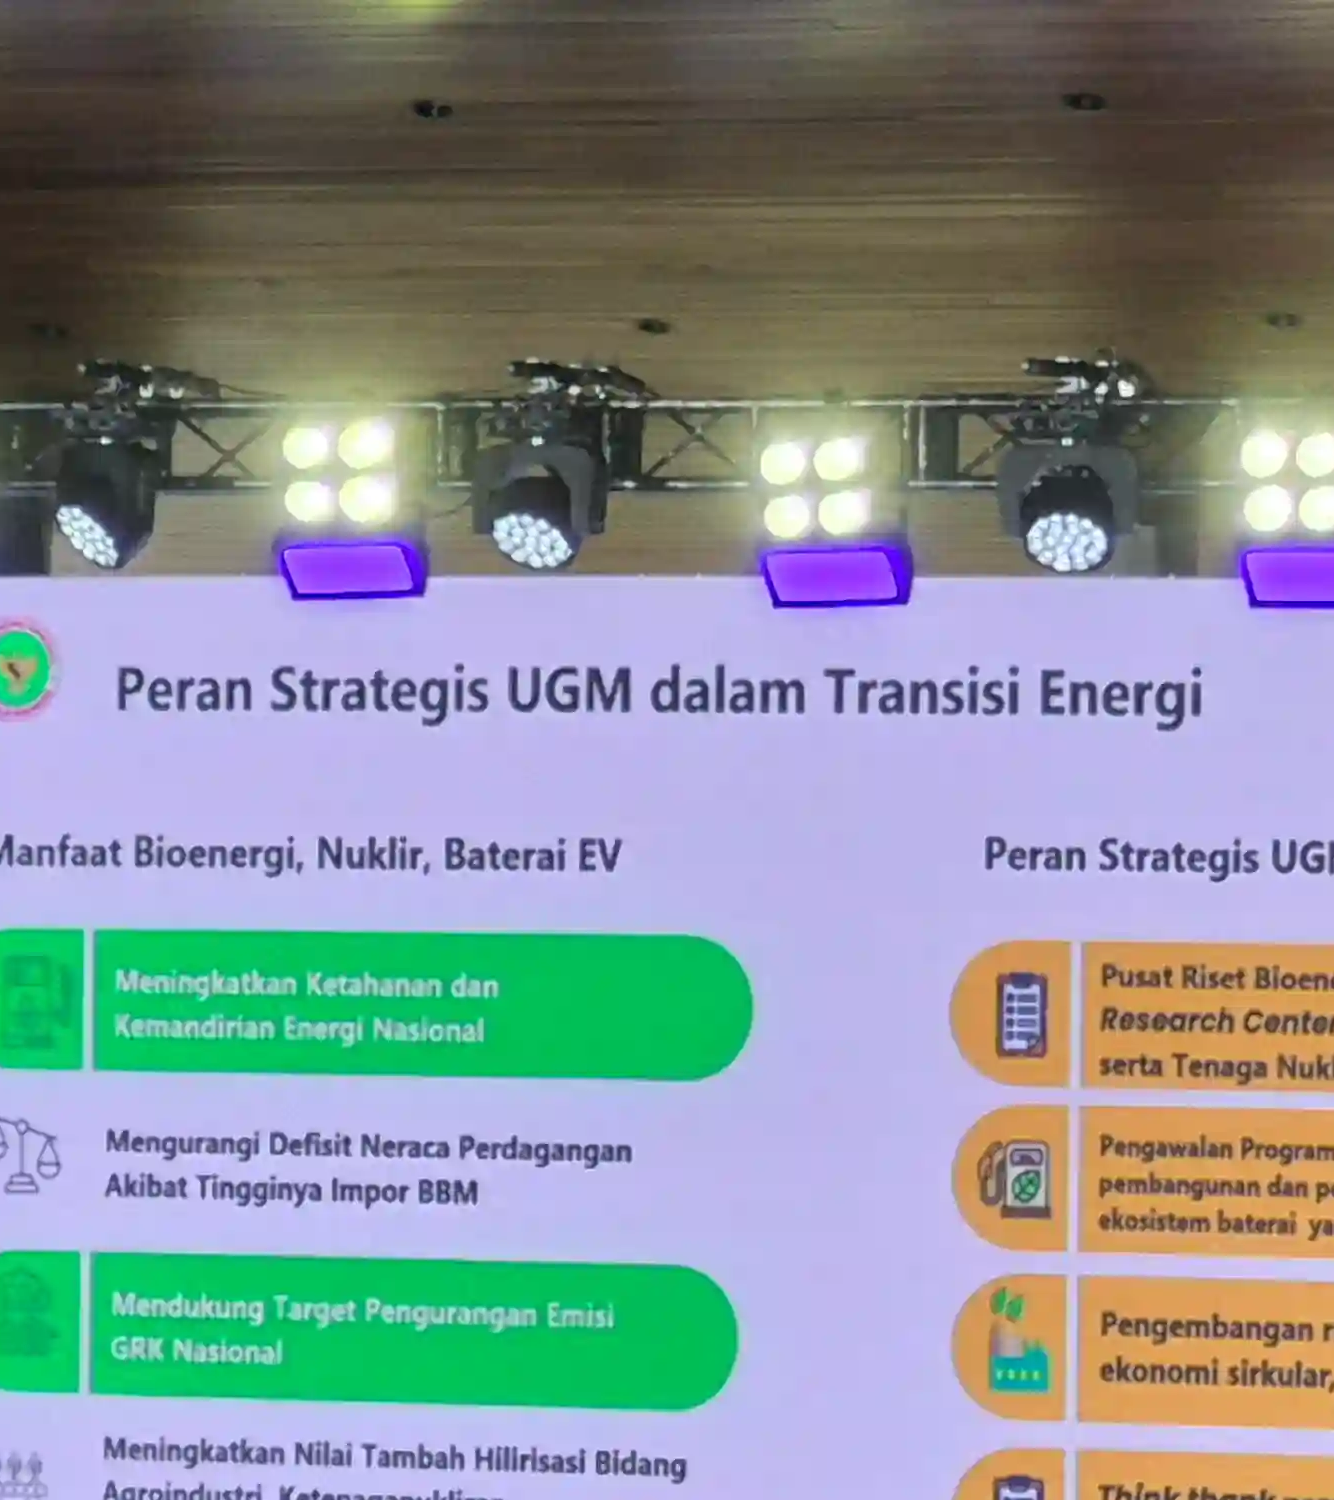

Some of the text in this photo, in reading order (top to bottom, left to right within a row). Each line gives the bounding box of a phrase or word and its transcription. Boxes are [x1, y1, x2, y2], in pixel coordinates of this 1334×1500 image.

[117, 666, 251, 714] Peran
[270, 664, 488, 726] Strategis
[507, 664, 630, 714] UGM
[651, 665, 805, 716] dalam
[828, 666, 1018, 714] Transisi
[1040, 667, 1202, 731] Energi
[134, 836, 303, 877] Bioenergi,
[318, 837, 429, 875] Nuklir,
[444, 837, 565, 872] Baterai
[579, 839, 621, 872] EV
[985, 837, 1085, 872] Peran
[1099, 837, 1259, 882] Strategis
[116, 970, 499, 1003] Meningkatkan Ketahanan dan
[1102, 964, 1173, 990] Pusat
[1183, 965, 1245, 990] Riset
[115, 1014, 484, 1047] Kemandirian Energi Nasional
[1100, 1007, 1234, 1033] Research
[1099, 1053, 1163, 1077] serta
[1171, 1053, 1267, 1085] Tenaga
[107, 1129, 632, 1169] Mengurangi Defisit Neraca Perdagangan
[1100, 1134, 1232, 1165] Pengawalan
[105, 1174, 478, 1209] Akibat Tingginya Impor BBM
[1099, 1172, 1261, 1203] pembangunan
[1267, 1174, 1308, 1198] dan
[1099, 1208, 1210, 1235] ekosistem
[1217, 1210, 1296, 1235] baterai
[111, 1292, 614, 1332] Mendukung Target Pengurangan Emisi
[1100, 1312, 1313, 1347] Pengembangan
[111, 1337, 282, 1365] GRK Nasional
[1100, 1356, 1220, 1385] ekonomi
[104, 1437, 687, 1484] Meningkatkan Nilai Tambah Hilirisasi Bidang
